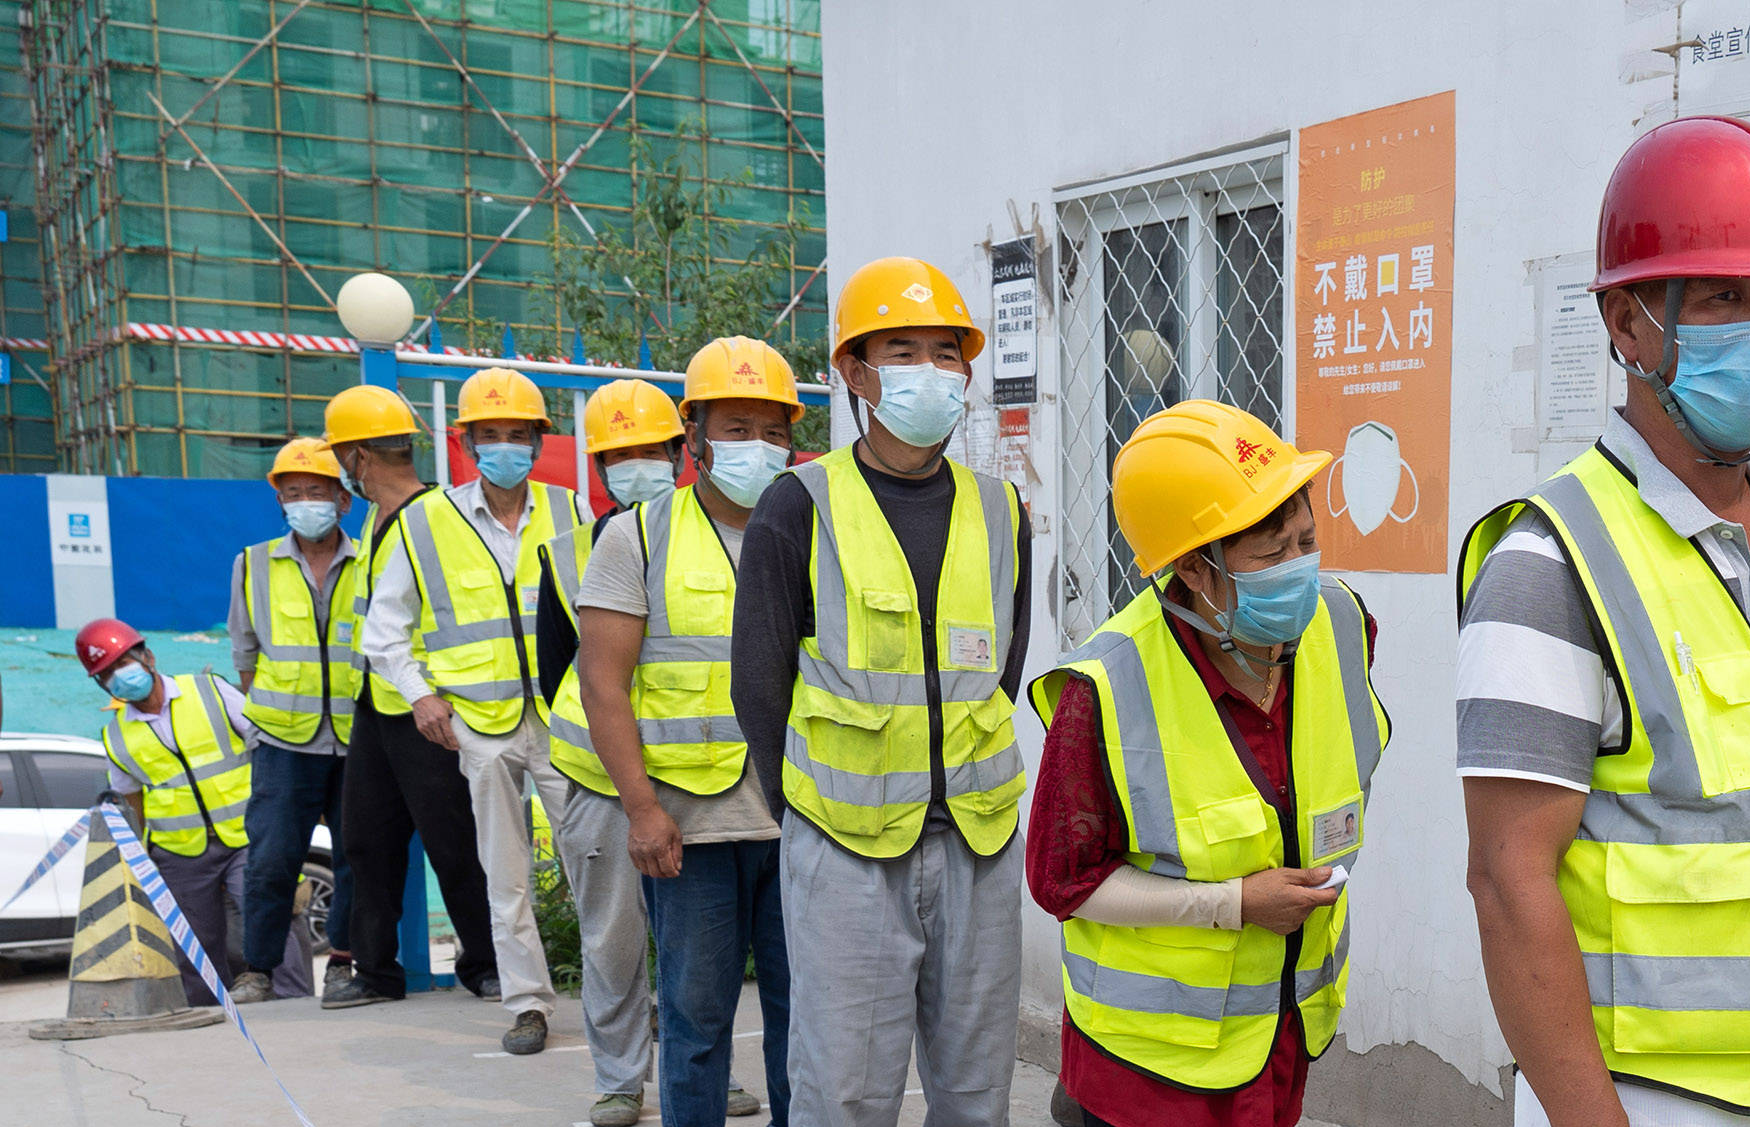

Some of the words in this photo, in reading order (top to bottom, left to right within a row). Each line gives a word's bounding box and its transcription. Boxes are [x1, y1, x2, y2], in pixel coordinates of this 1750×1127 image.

[1360, 166, 1386, 193] 防护
[1314, 244, 1435, 306] 不戴口罩
[1312, 301, 1434, 360] 禁止入内
